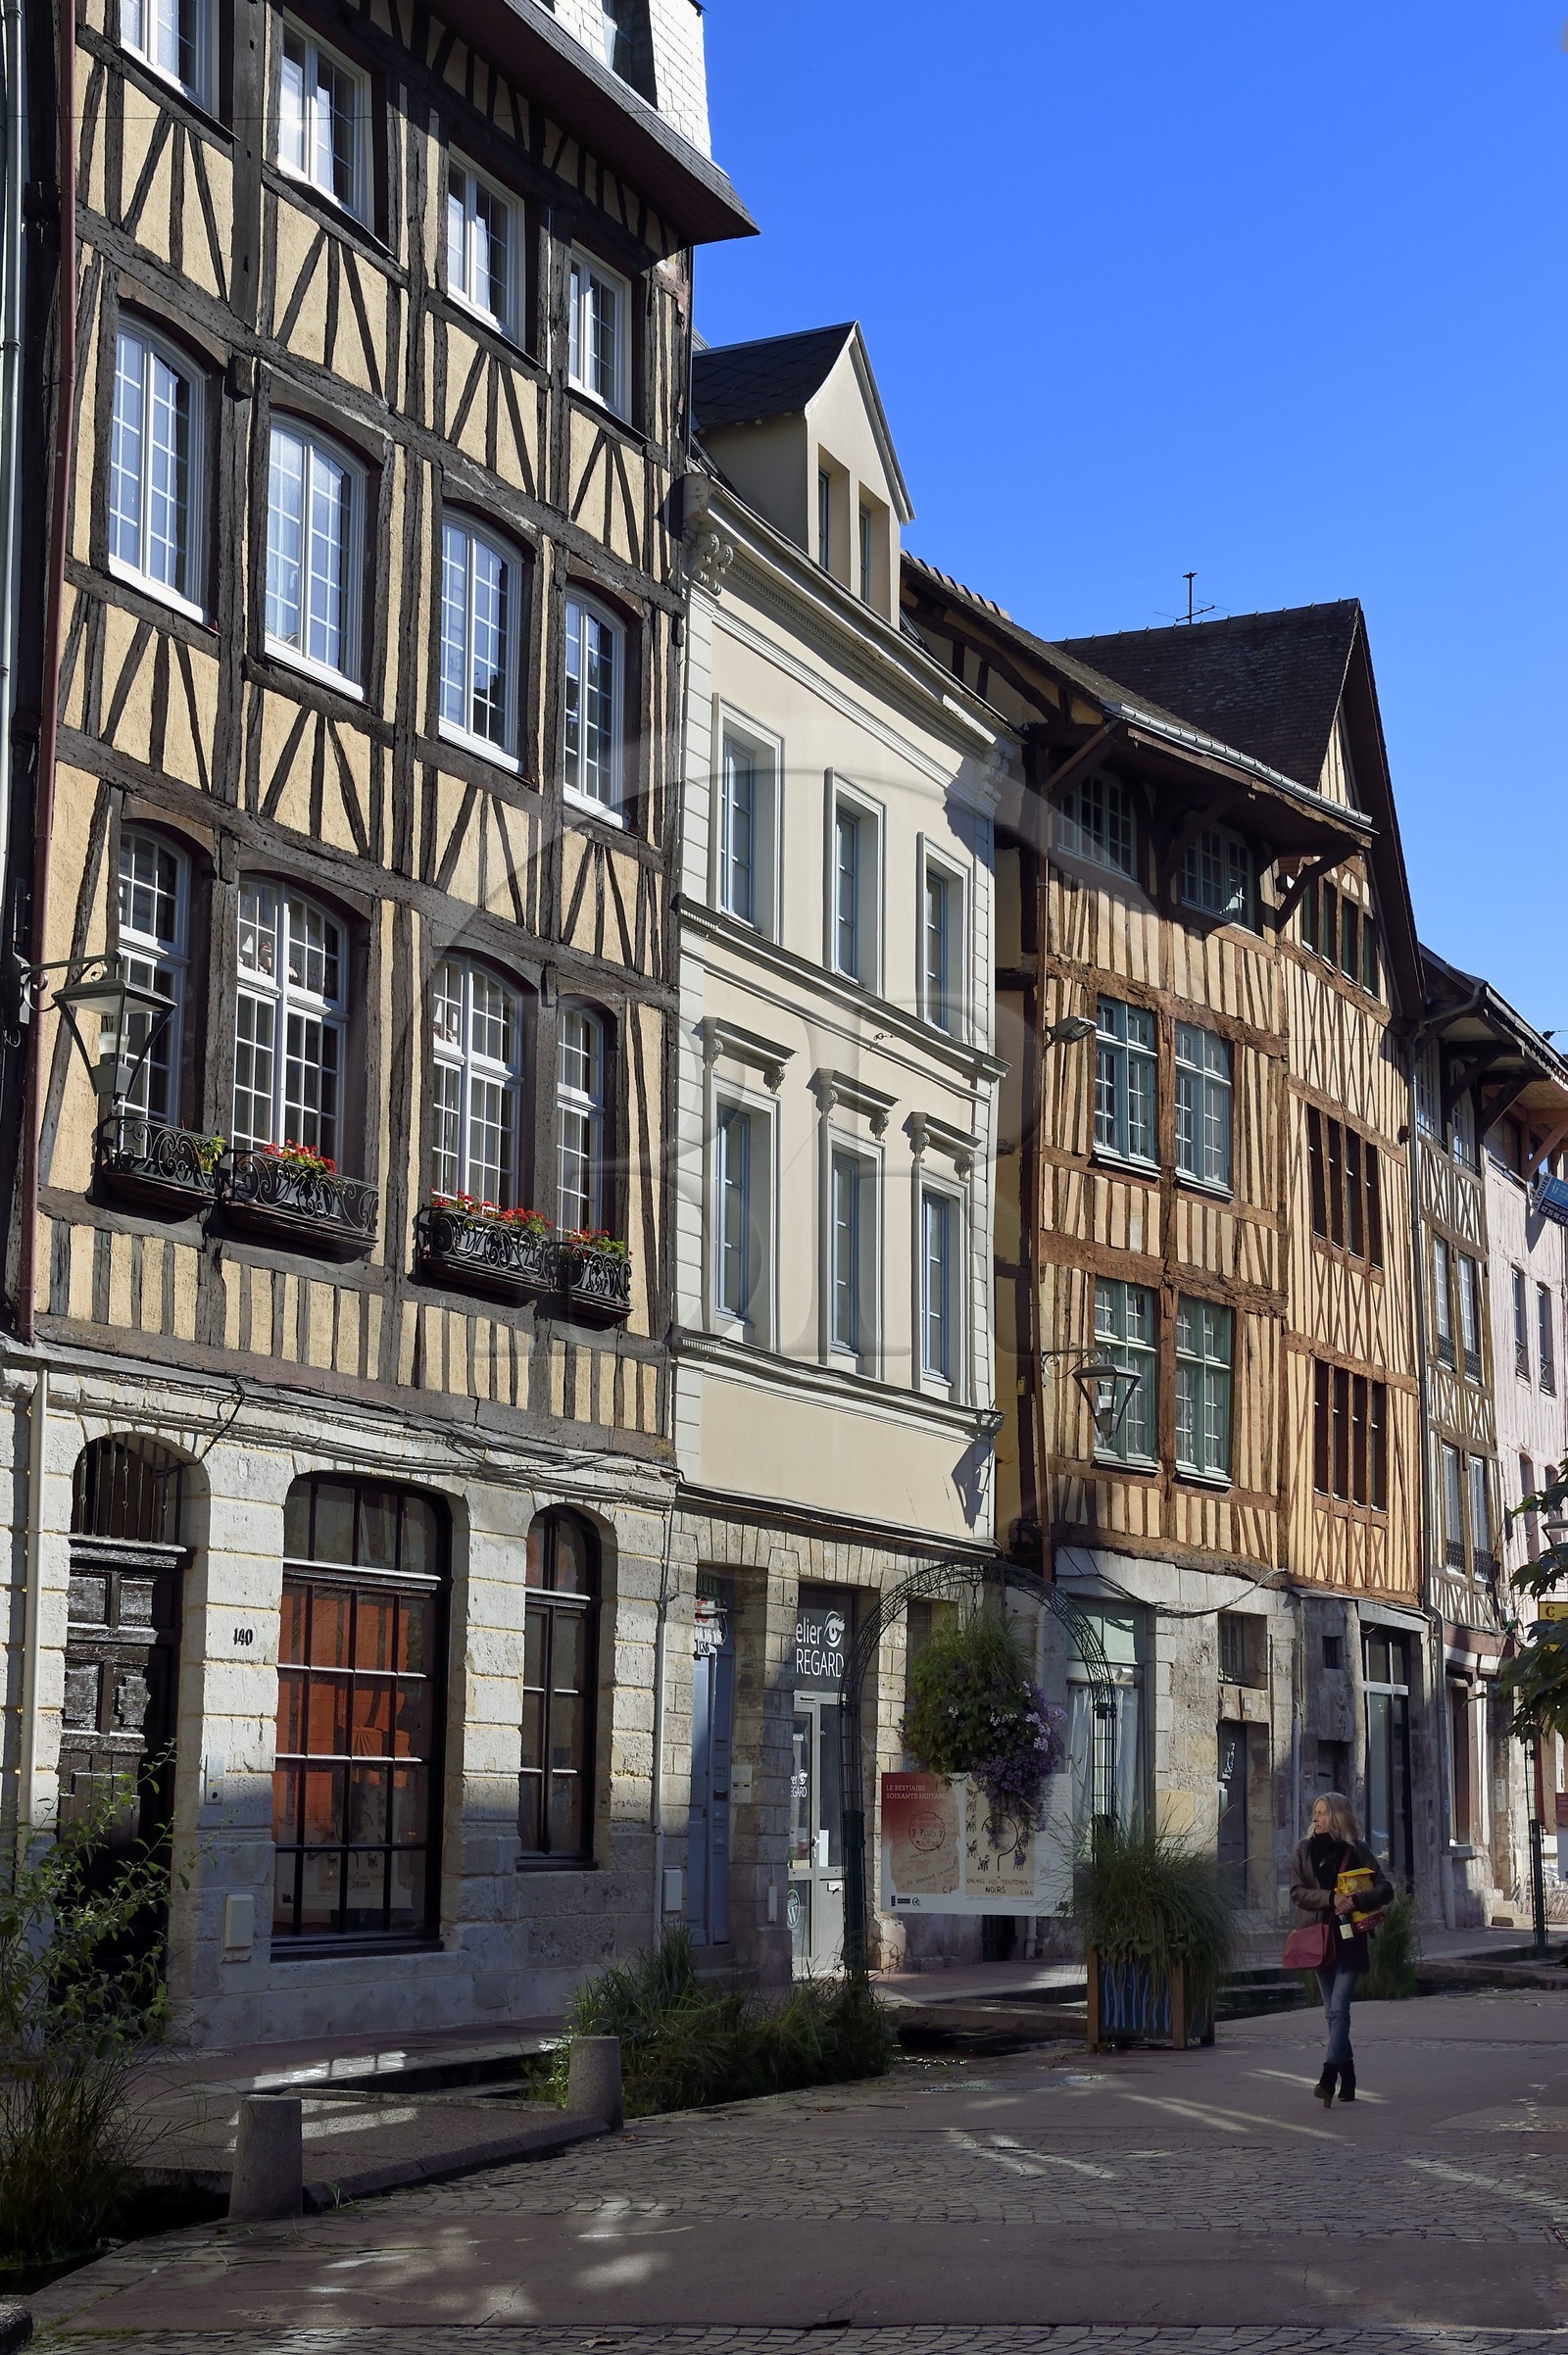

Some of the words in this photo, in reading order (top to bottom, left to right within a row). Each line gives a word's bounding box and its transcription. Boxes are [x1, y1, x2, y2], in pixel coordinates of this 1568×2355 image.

[1536, 1176, 1551, 1202] LOUER
[232, 1628, 253, 1646] 140
[796, 1648, 844, 1678] REGARD
[919, 1828, 937, 1838] PLUS
[985, 1886, 1006, 1894] NOIRS
